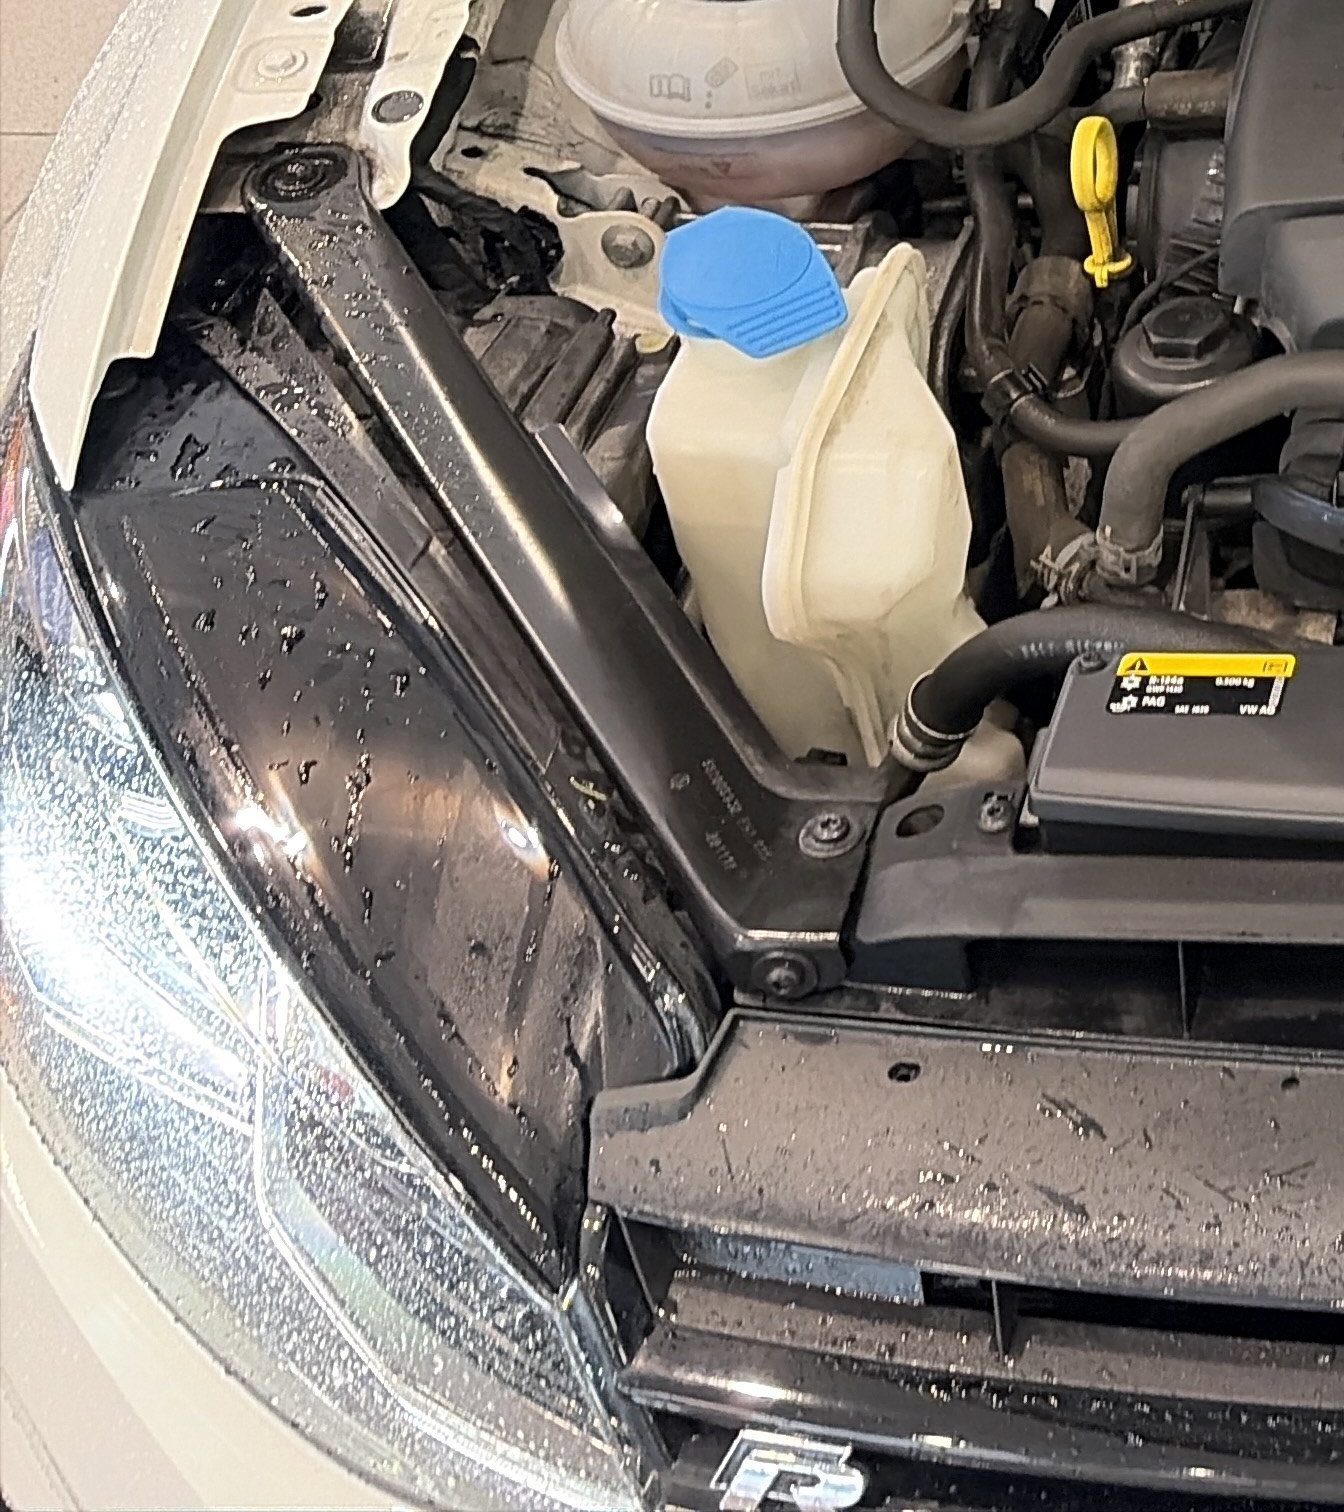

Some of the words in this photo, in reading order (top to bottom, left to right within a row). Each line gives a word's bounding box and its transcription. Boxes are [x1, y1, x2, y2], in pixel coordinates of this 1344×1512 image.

[1142, 696, 1165, 707] PAG
[1239, 705, 1257, 714] VW
[1259, 706, 1276, 715] AG
[711, 1429, 868, 1512] R
